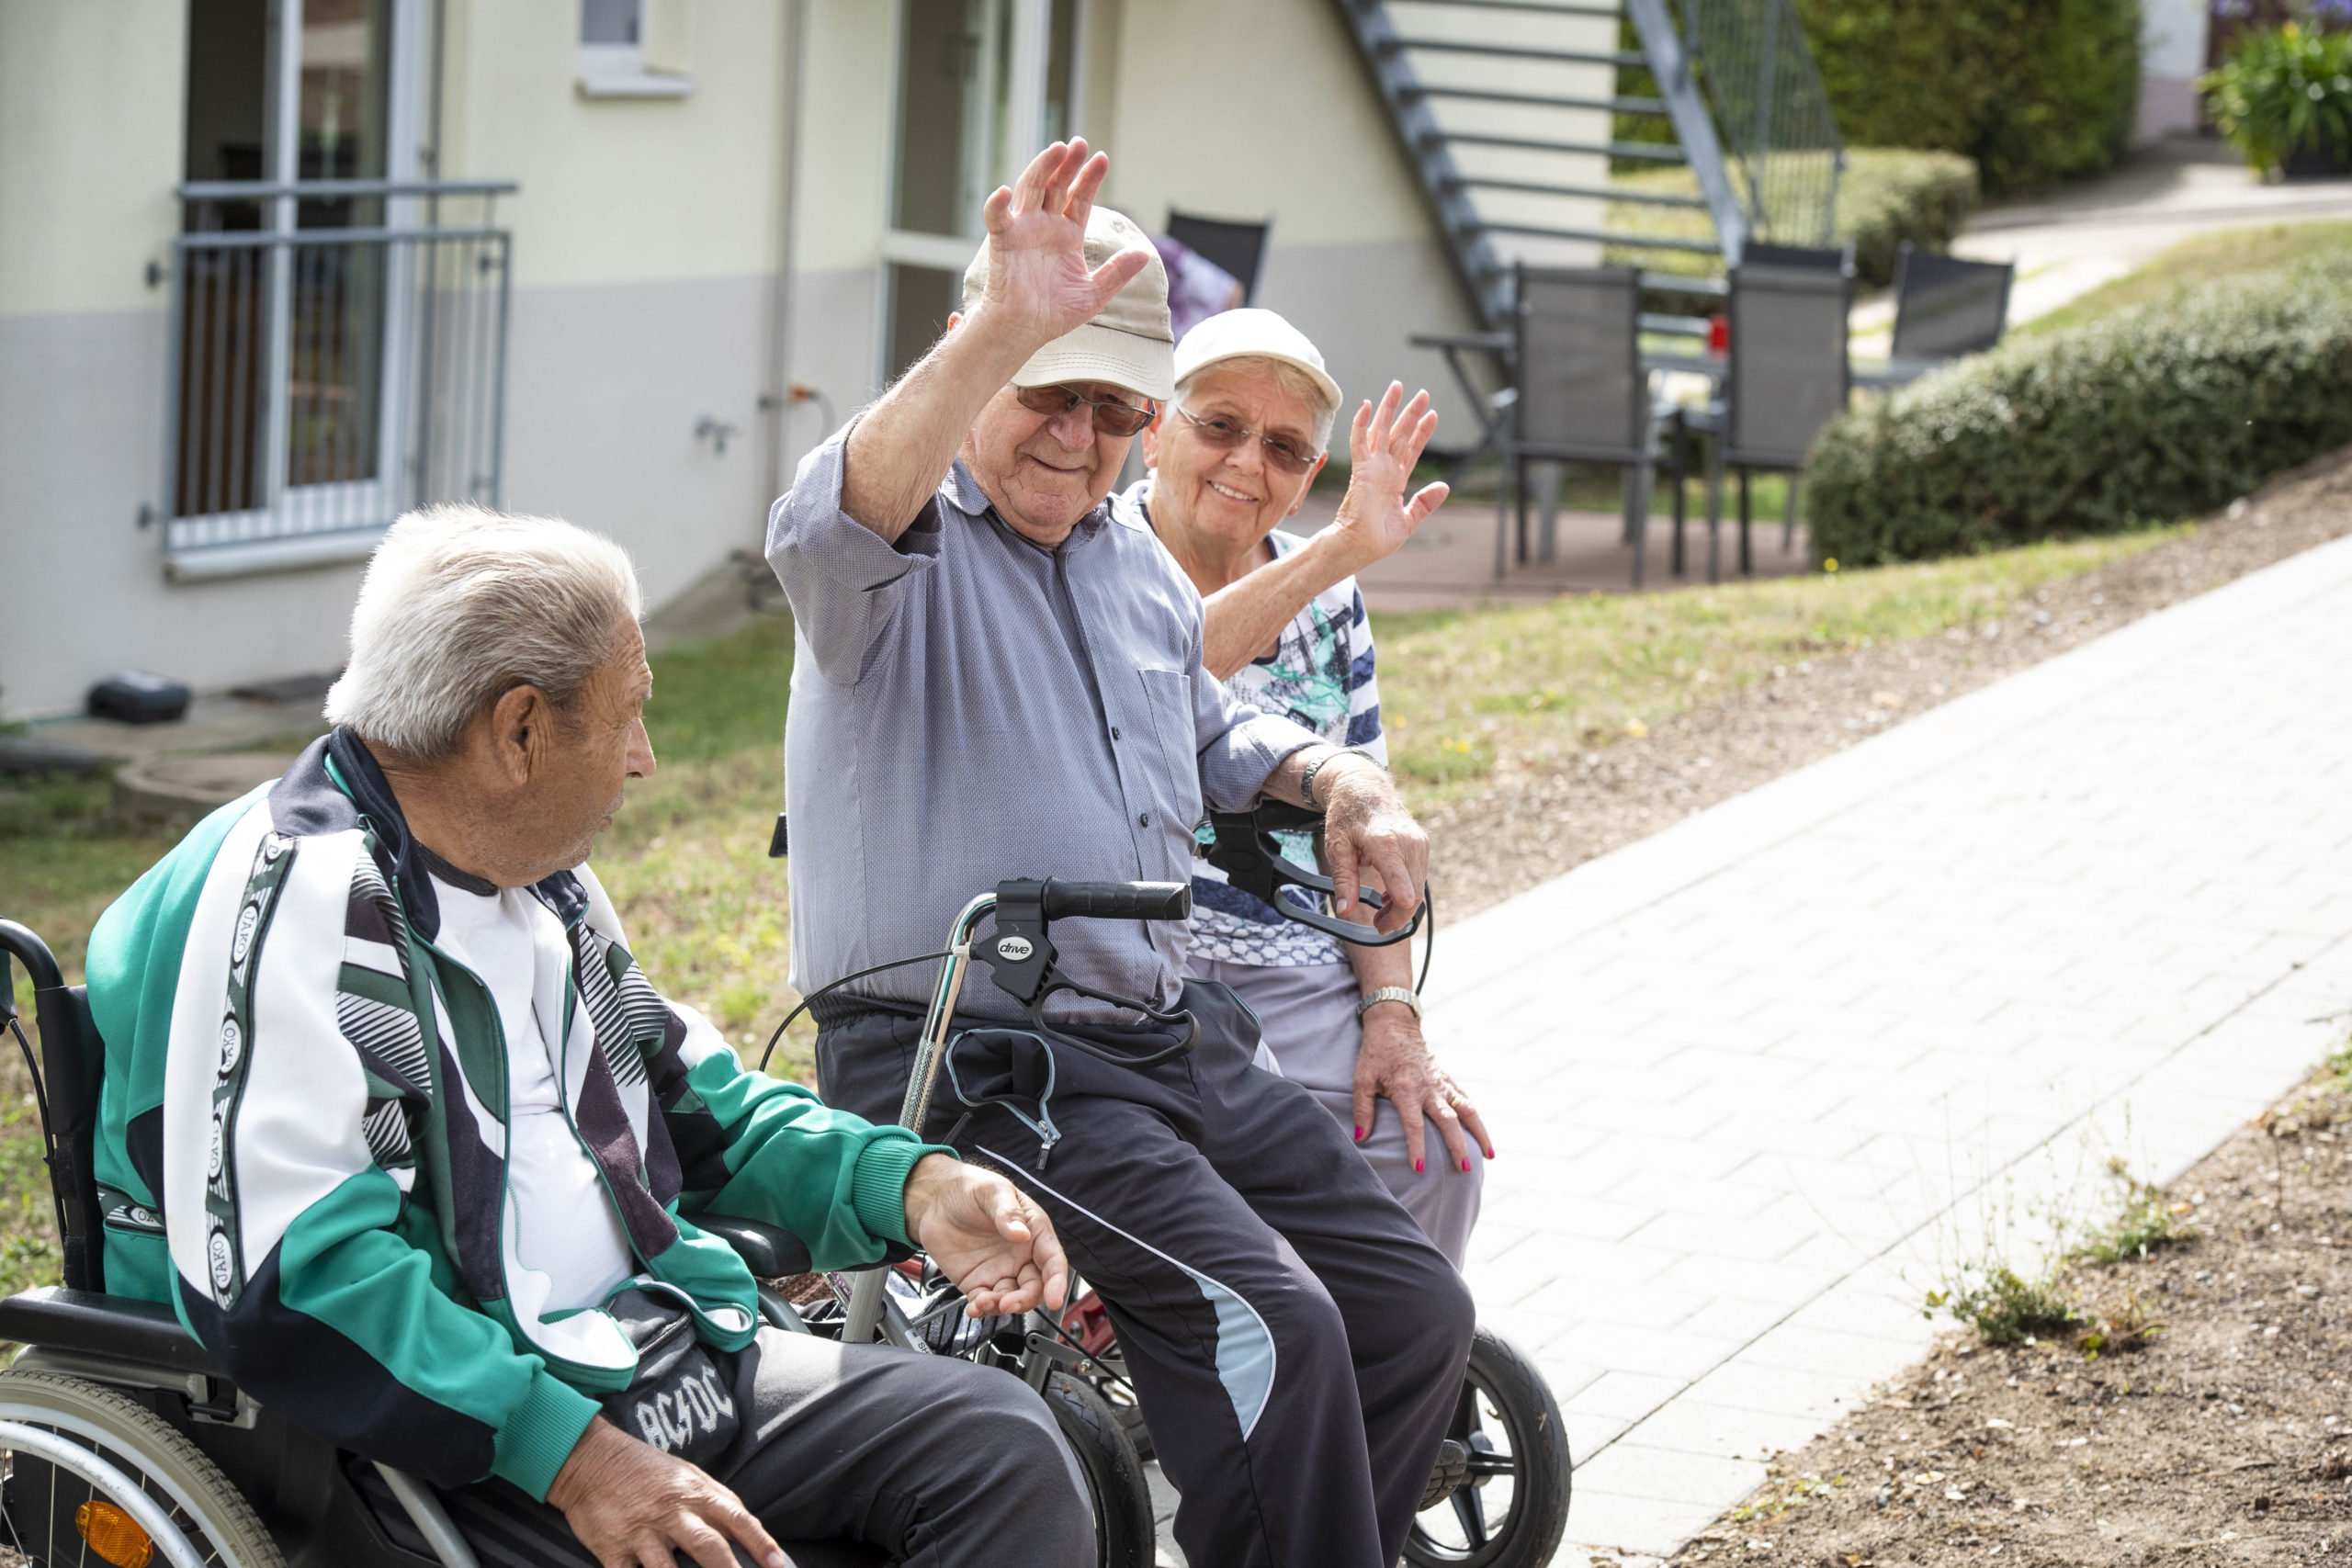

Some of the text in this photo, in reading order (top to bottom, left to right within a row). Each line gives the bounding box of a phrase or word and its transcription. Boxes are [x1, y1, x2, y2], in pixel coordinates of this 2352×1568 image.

[236, 910, 255, 954] JAKO
[999, 942, 1030, 954] drive
[212, 1240, 228, 1282] JAKO
